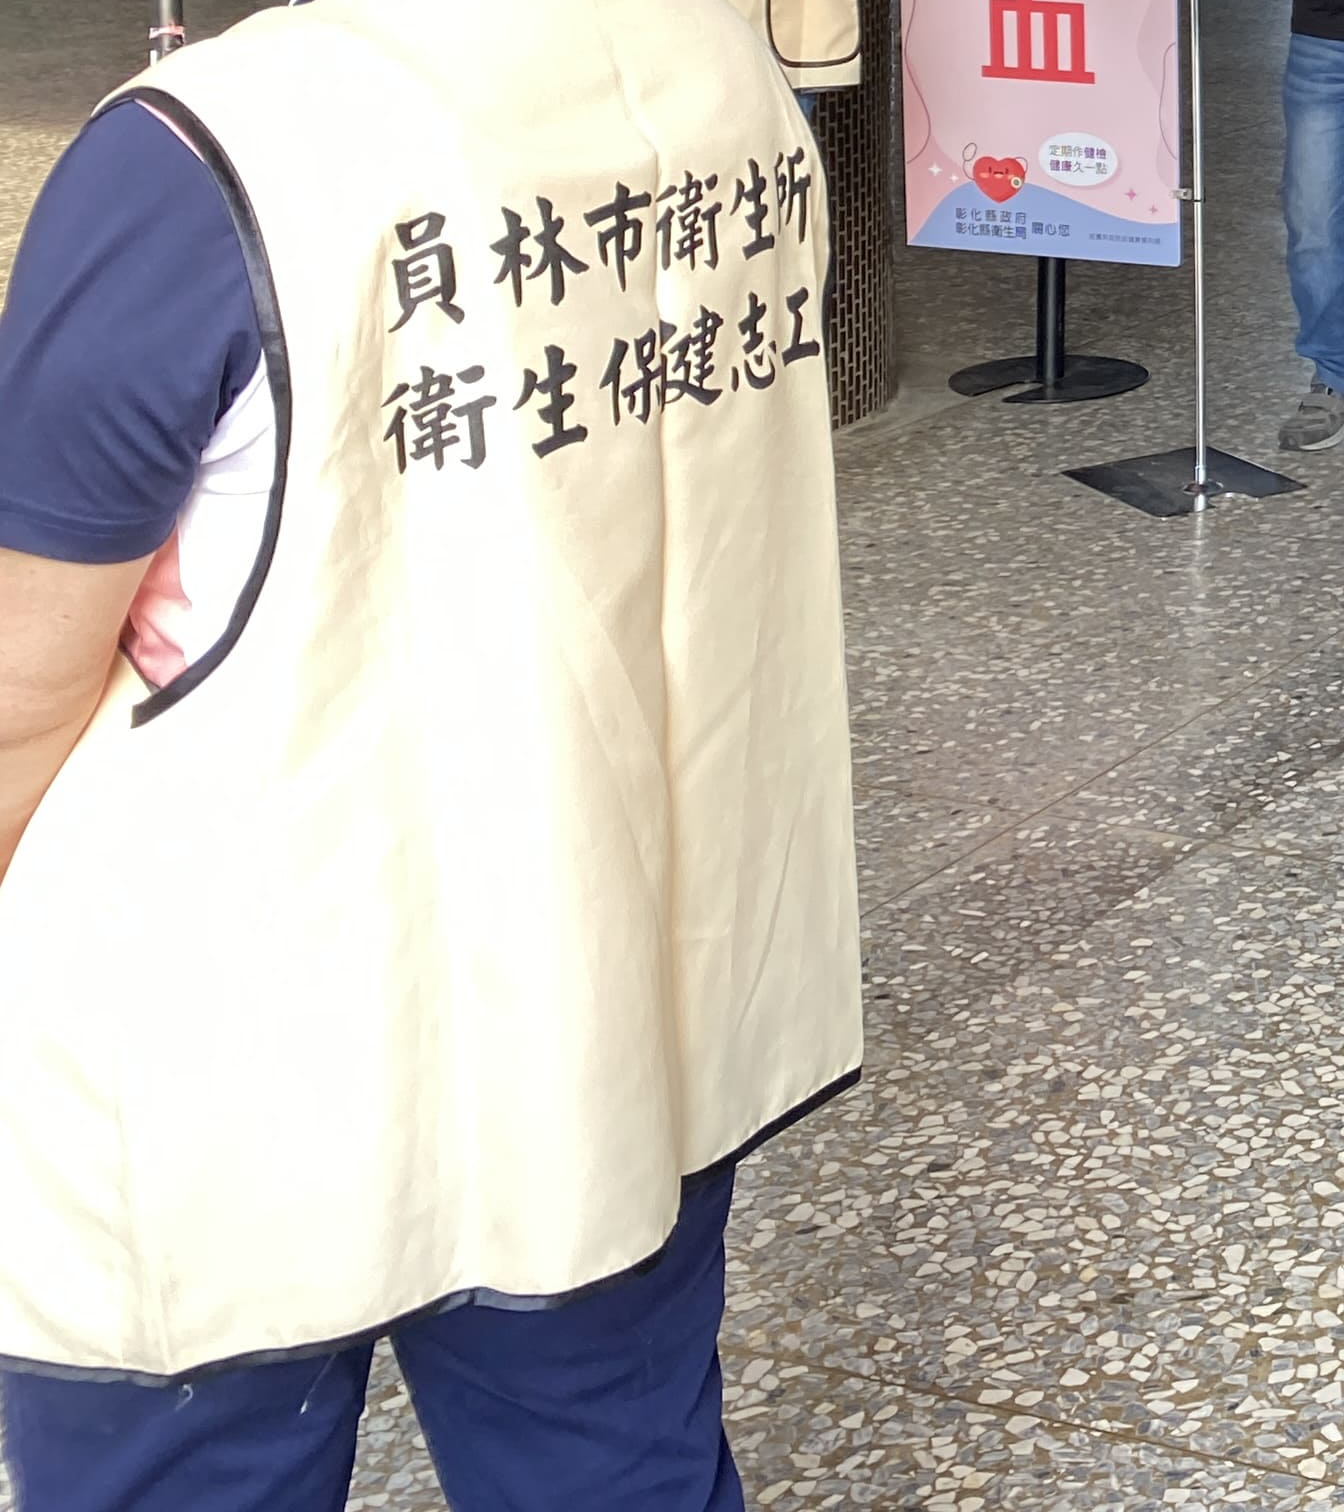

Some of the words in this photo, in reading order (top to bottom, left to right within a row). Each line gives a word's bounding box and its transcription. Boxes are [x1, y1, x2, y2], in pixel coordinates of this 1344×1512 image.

[1049, 144, 1107, 160] 定期作健檢
[1049, 159, 1108, 175] 健康久一點
[955, 207, 1027, 224] 彰化縣政府
[955, 222, 1027, 240] 彰化縣衛生局
[1031, 222, 1071, 237] 關心您
[388, 146, 811, 333] 員林市衛生所
[381, 287, 821, 474] 衛生保健志工
